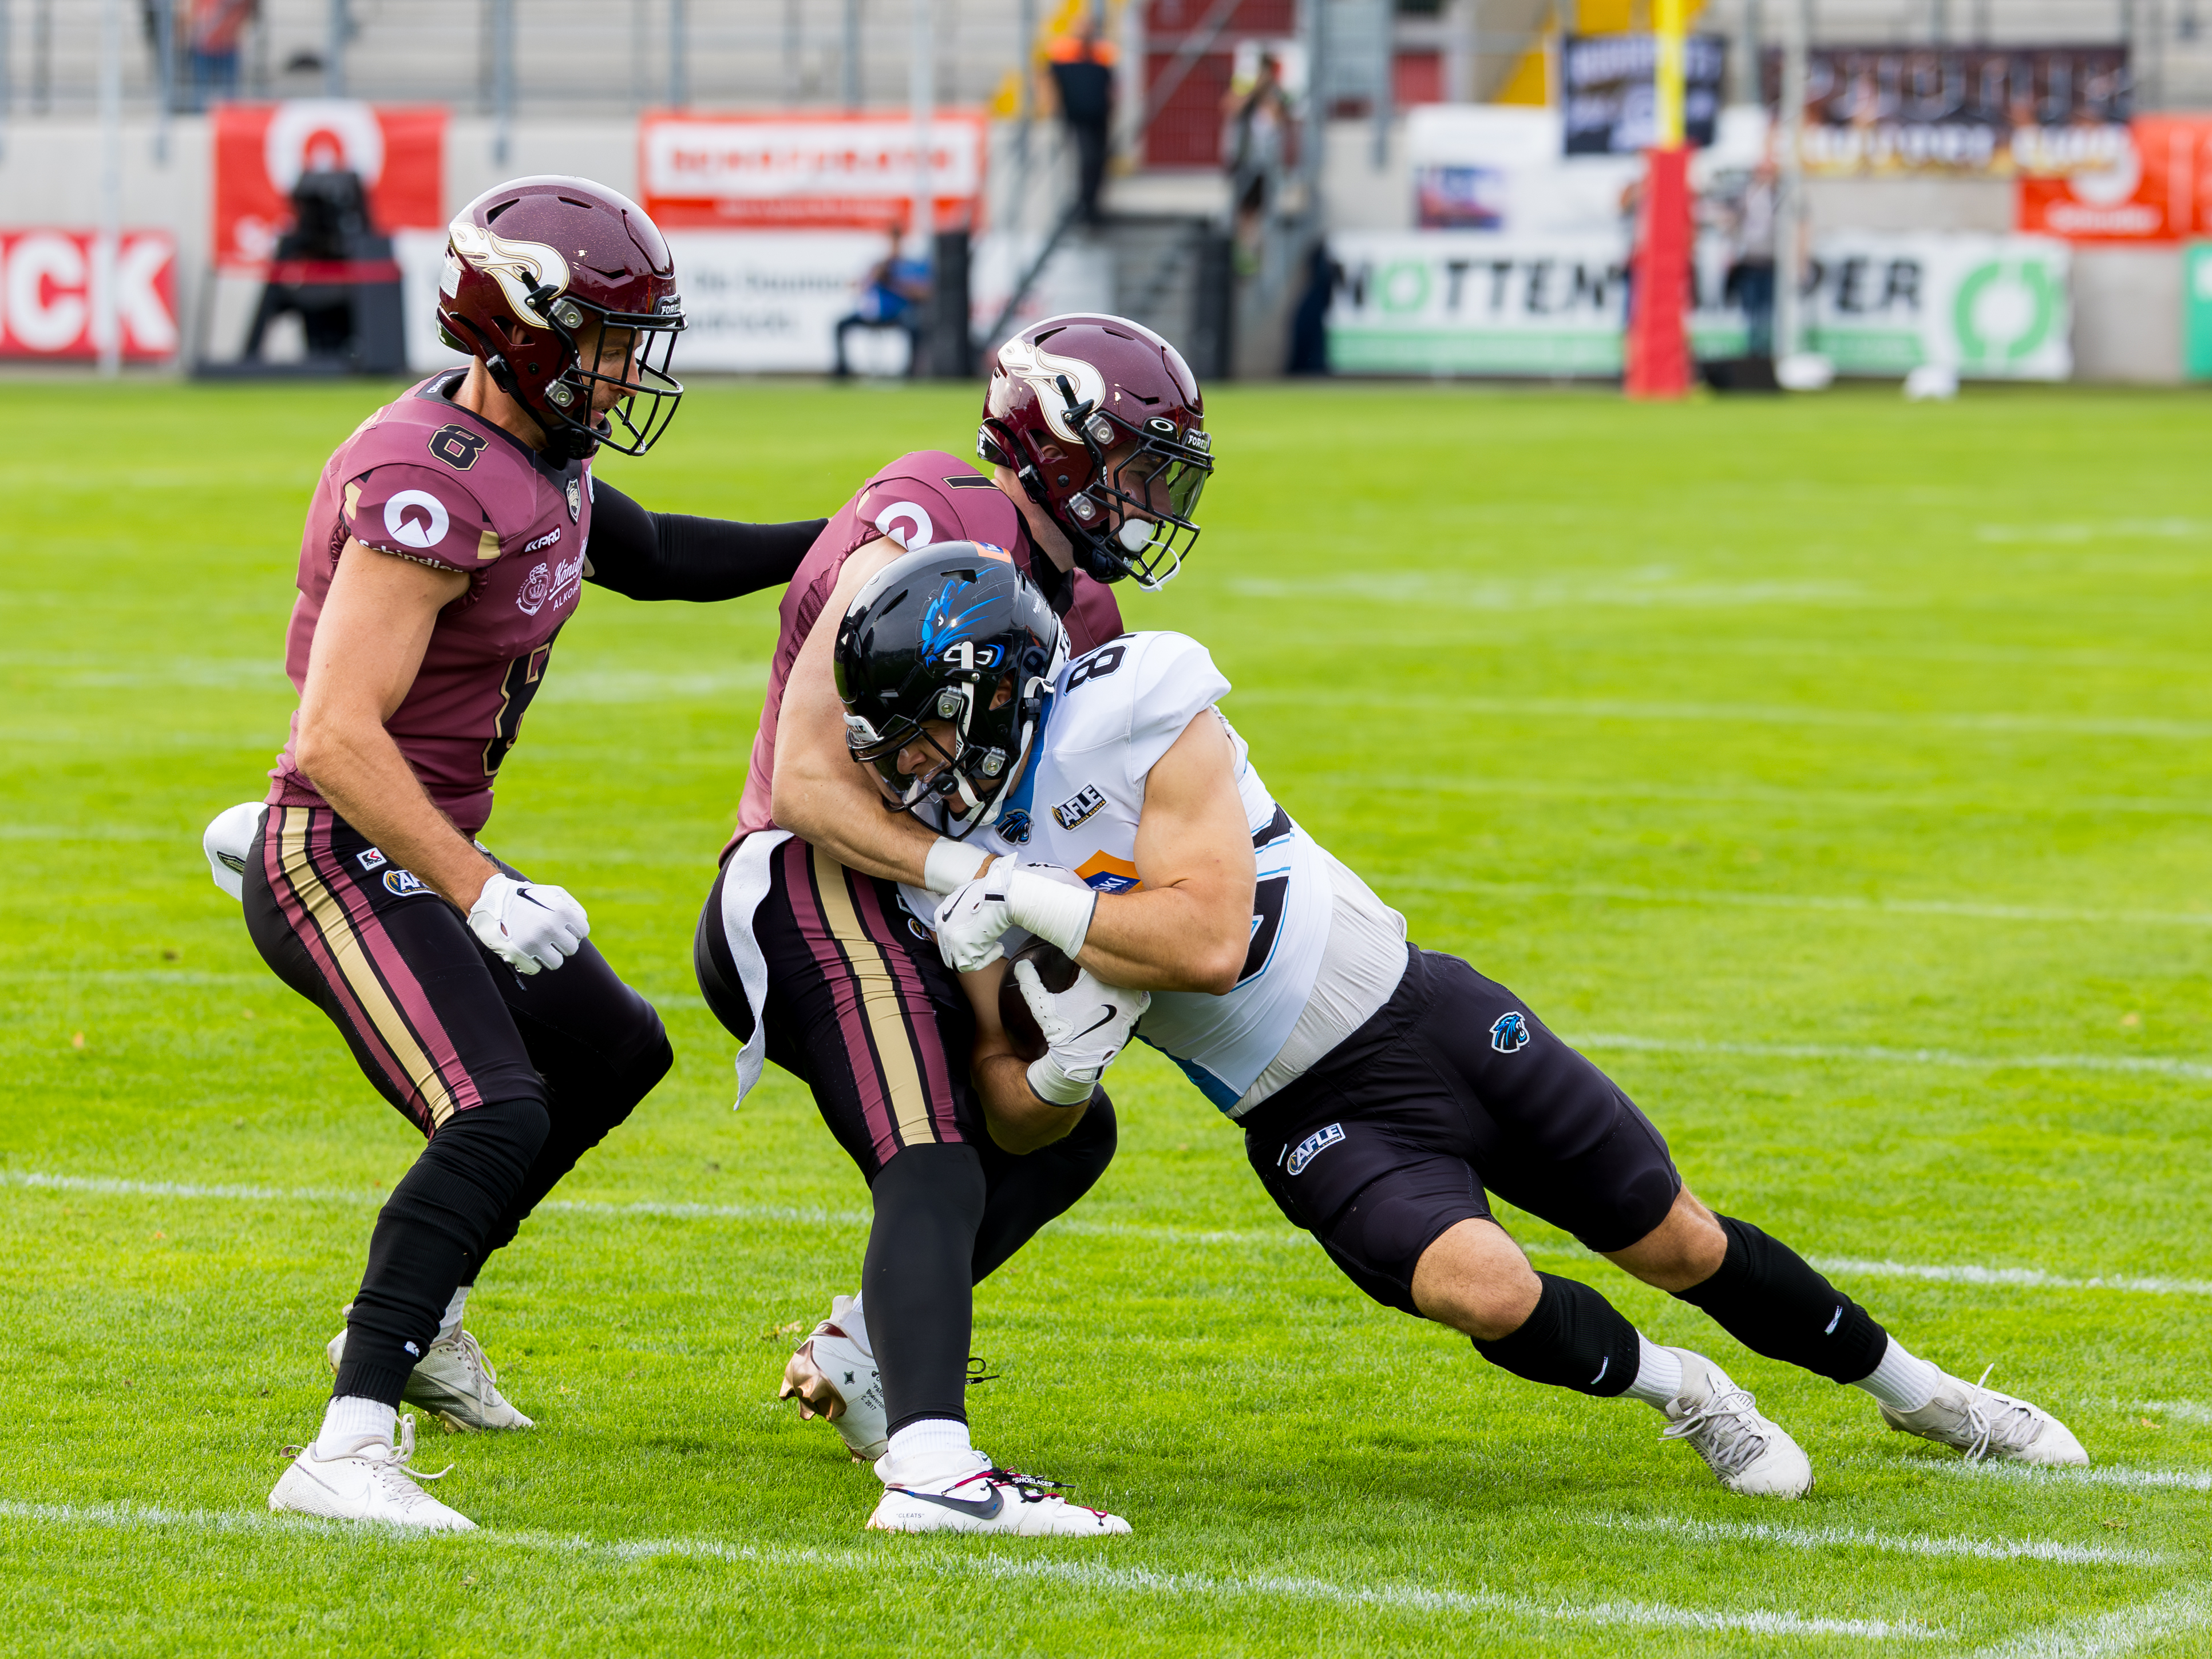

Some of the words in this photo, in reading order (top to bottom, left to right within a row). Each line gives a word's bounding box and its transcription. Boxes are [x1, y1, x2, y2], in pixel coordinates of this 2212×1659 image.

[0, 235, 179, 349] CK
[427, 423, 490, 471] 8
[1059, 786, 1103, 826] AFLE
[1296, 1126, 1340, 1168] AFLE
[865, 1400, 877, 1411] 2017
